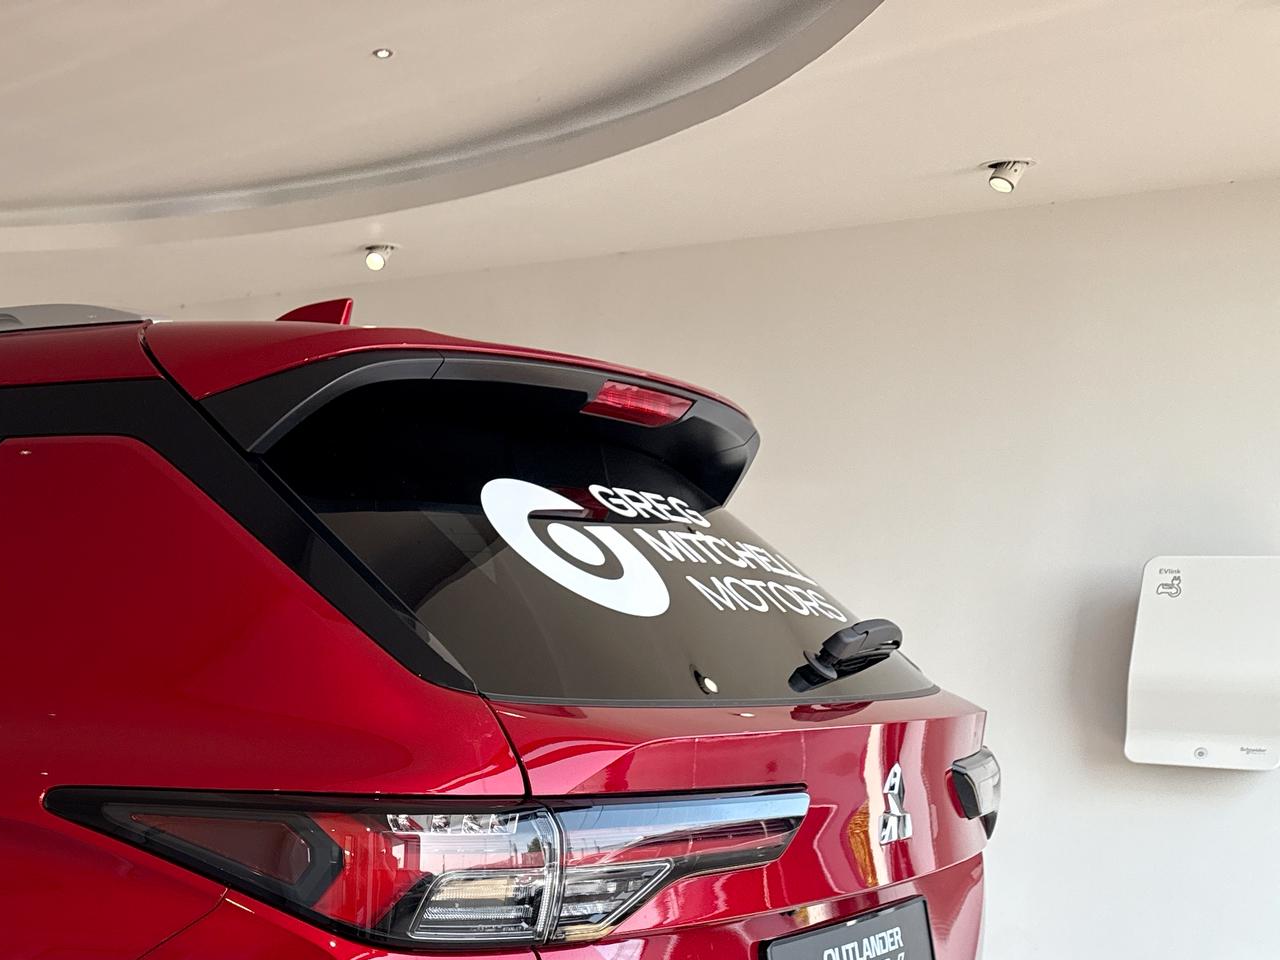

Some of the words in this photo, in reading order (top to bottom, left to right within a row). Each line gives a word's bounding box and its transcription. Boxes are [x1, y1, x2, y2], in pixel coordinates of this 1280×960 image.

[588, 484, 711, 528] GREG
[633, 527, 818, 586] MITCHELL
[685, 575, 847, 622] MOTORS
